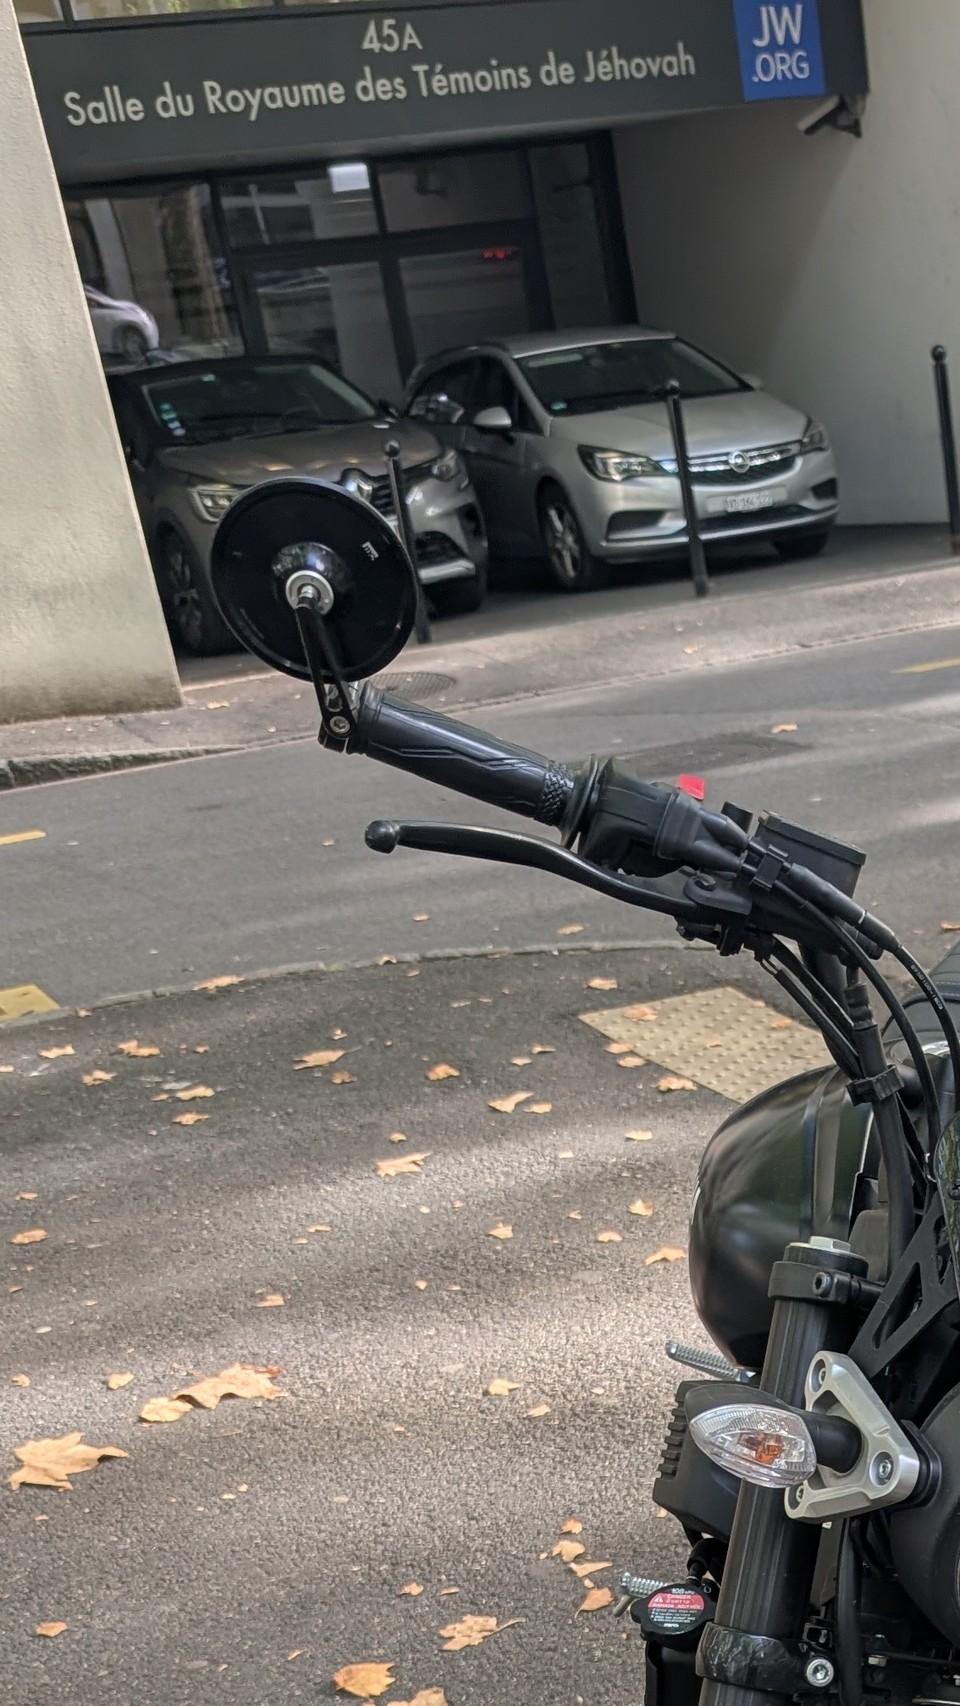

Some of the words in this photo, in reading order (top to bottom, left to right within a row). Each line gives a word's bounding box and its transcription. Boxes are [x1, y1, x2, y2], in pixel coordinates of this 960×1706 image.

[362, 18, 423, 53] 45A
[752, 3, 803, 48] JW
[63, 85, 146, 127] Salle
[155, 81, 196, 120] du
[203, 79, 347, 122] Royaume
[355, 66, 408, 102] des
[412, 58, 533, 98] Témoins
[539, 50, 576, 87] de
[584, 41, 697, 84] Jéhovah
[752, 50, 811, 84] .ORG
